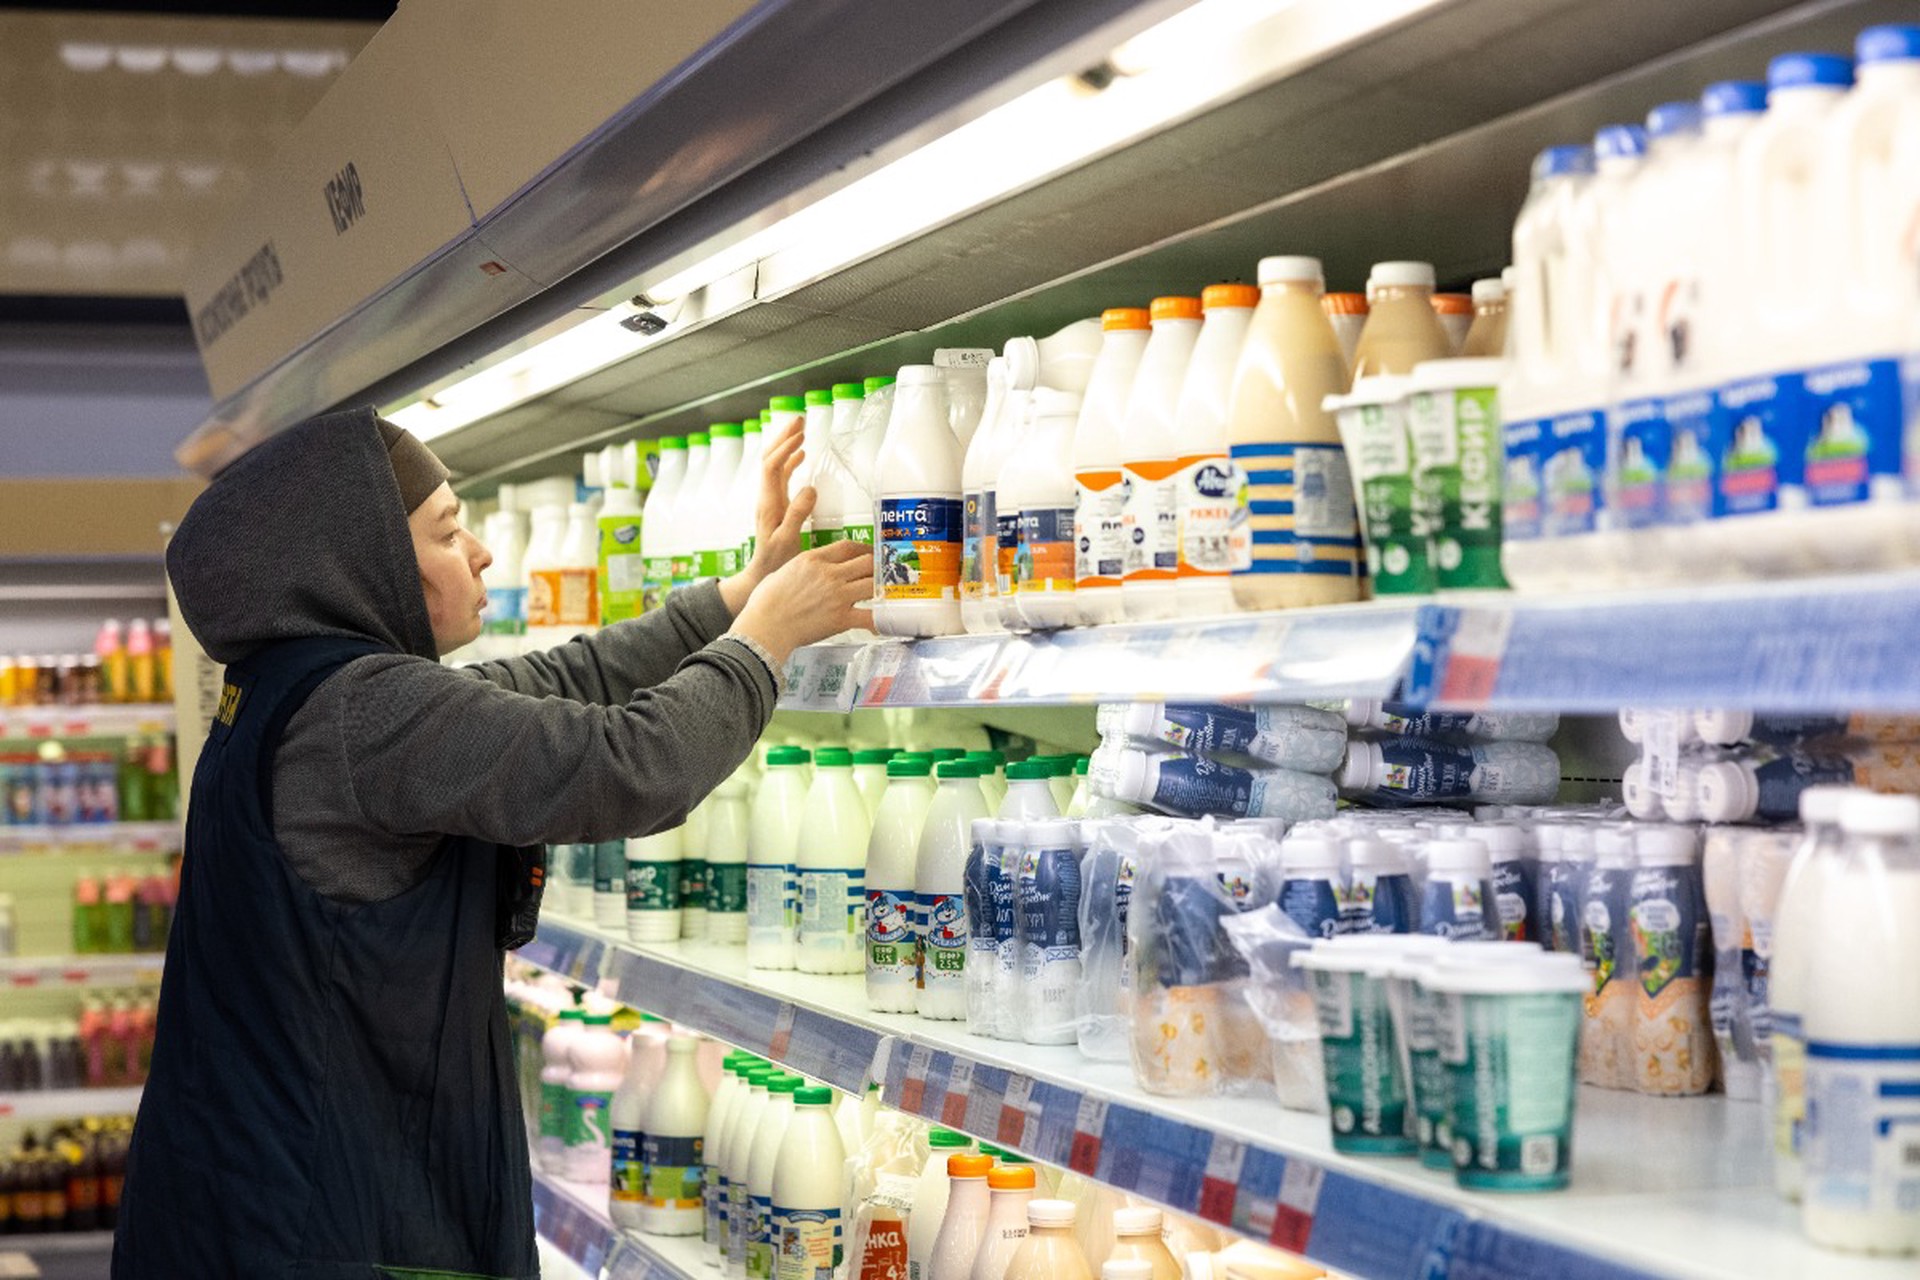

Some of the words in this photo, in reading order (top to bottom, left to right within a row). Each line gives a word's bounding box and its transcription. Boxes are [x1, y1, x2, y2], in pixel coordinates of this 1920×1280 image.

[323, 161, 366, 236] КЕФИР
[1460, 396, 1491, 530] КЕФИР
[866, 1231, 901, 1249] нка
